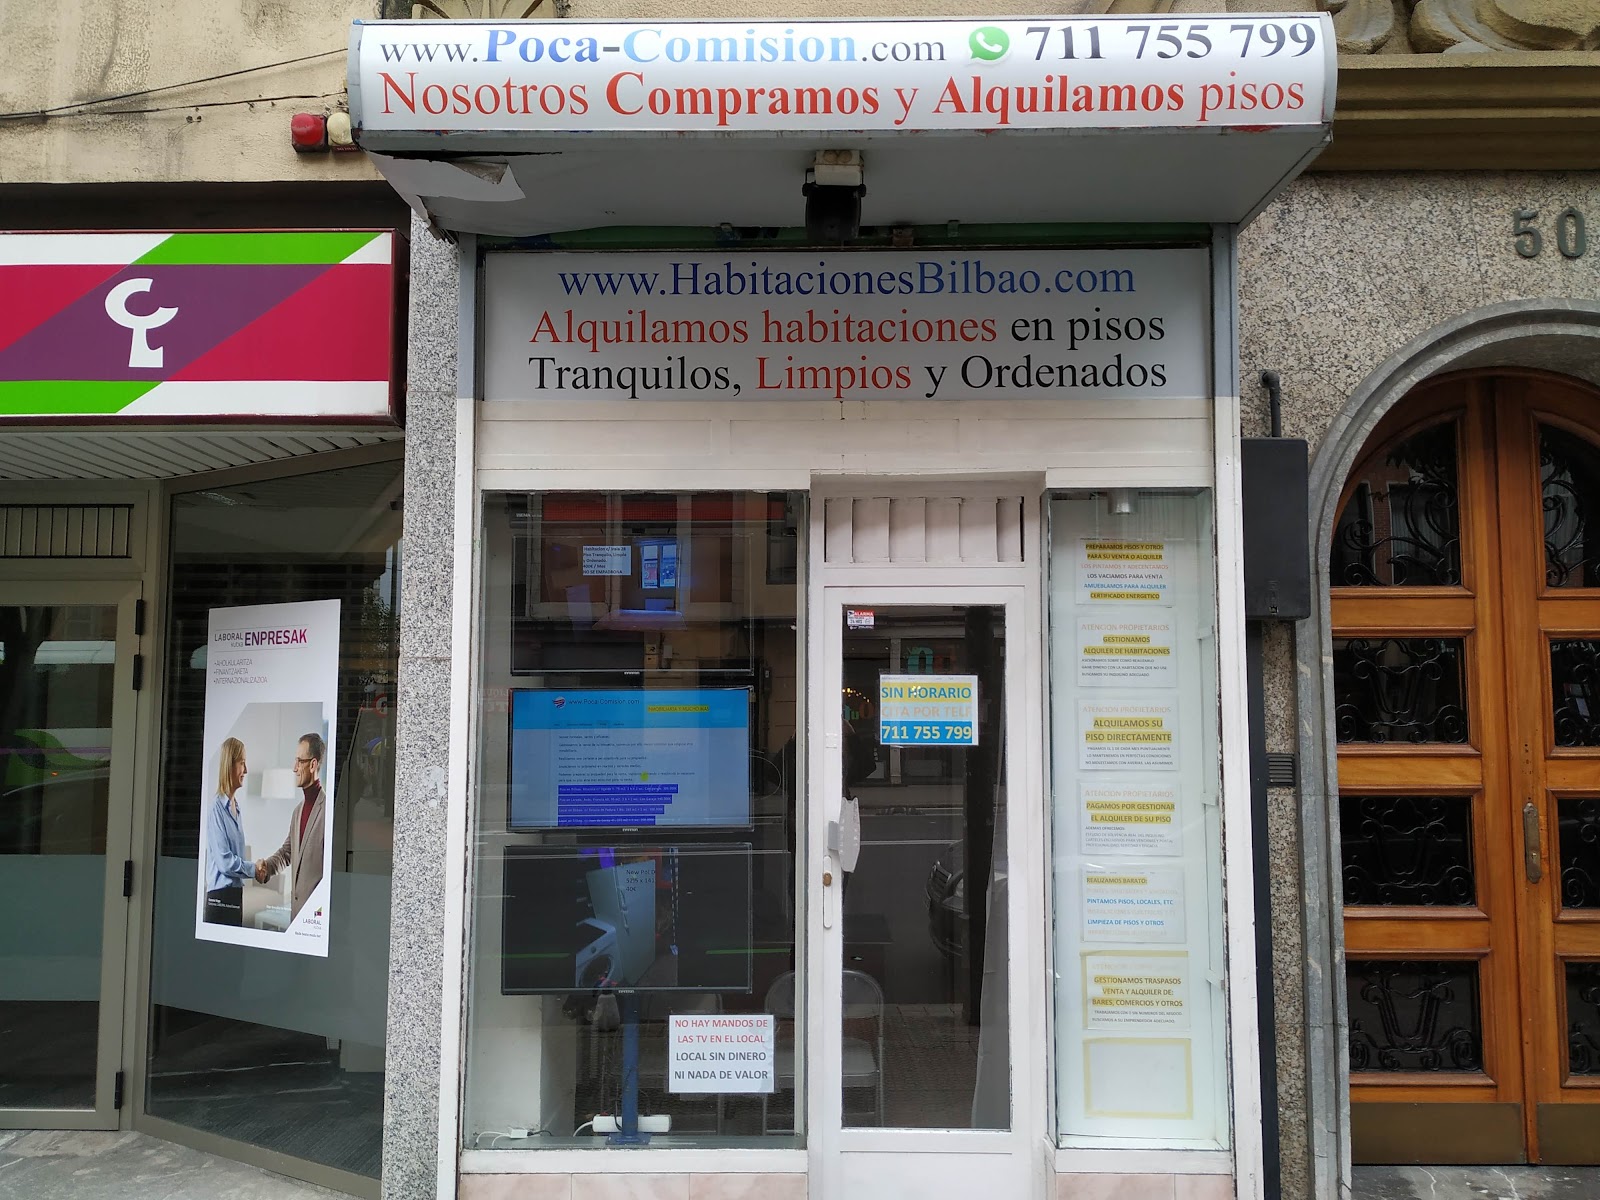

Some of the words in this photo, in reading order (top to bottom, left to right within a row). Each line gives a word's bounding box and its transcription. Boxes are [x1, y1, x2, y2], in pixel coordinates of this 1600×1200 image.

[380, 28, 946, 63] www.Poca-Comision.com
[1026, 26, 1106, 61] 711
[1125, 24, 1212, 60] 755
[1229, 22, 1316, 58] 799
[377, 72, 588, 116] Nosotros
[605, 71, 879, 127] Compramos
[894, 87, 918, 125] y
[932, 74, 1185, 125] Alquilamos
[1197, 71, 1304, 122] pisos
[1513, 207, 1587, 258] 50
[557, 261, 1135, 297] www.HabitacionesBilbao.com
[529, 307, 749, 352] Alquilamos
[761, 307, 998, 344] habitaciones
[1010, 314, 1055, 342] en
[1067, 307, 1165, 351] pisos
[528, 355, 742, 400] Tranquilos,
[755, 355, 912, 399] Limpios
[924, 363, 948, 399] y
[960, 352, 1167, 390] Ordenados
[214, 633, 243, 642] LABORAL
[245, 629, 308, 646] ENPRESAK
[882, 687, 903, 698] SIN
[908, 687, 971, 698] HORARIO
[882, 707, 910, 716] CITA
[914, 707, 939, 716] POR
[882, 726, 908, 739] 711
[914, 726, 940, 739] 755
[945, 726, 972, 739] 799
[676, 1052, 706, 1060] LOCAL
[710, 1052, 725, 1060] SIN
[729, 1052, 766, 1060] DINERO
[675, 1071, 684, 1079] NI
[688, 1071, 716, 1079] NADA
[720, 1071, 732, 1079] DE
[735, 1071, 768, 1079] VALOR
